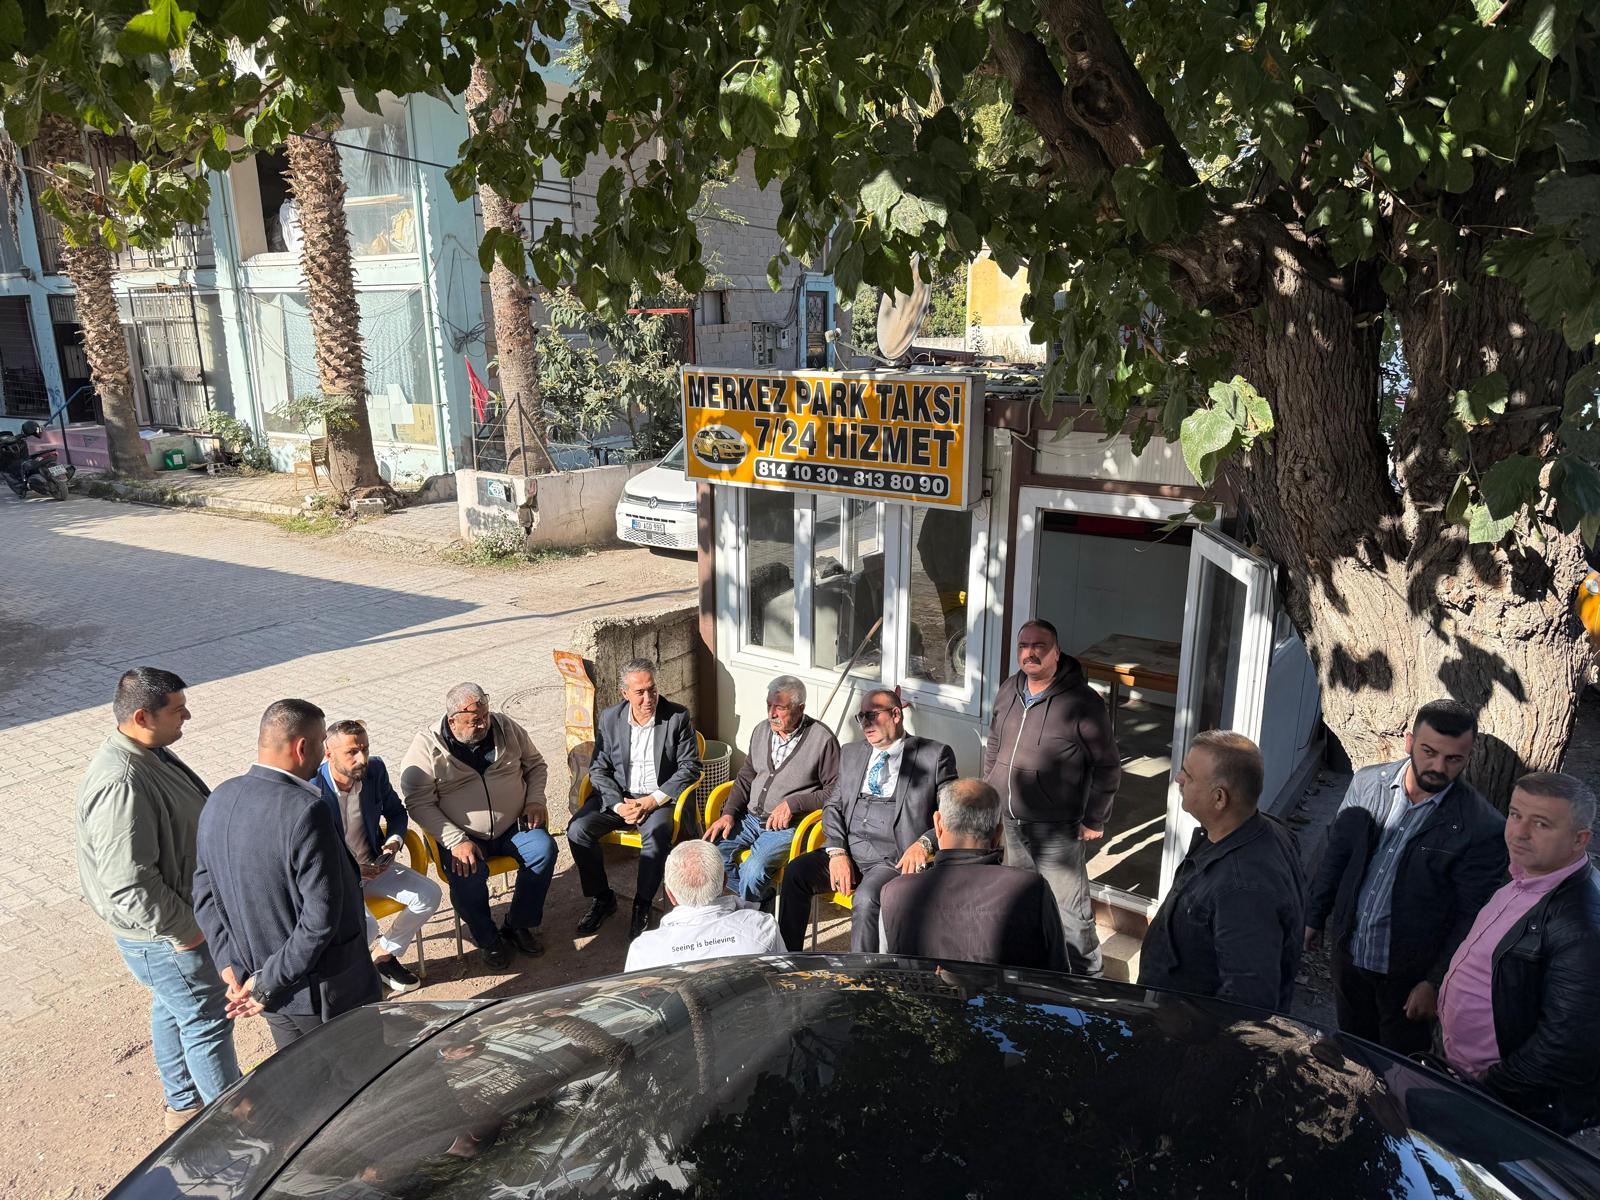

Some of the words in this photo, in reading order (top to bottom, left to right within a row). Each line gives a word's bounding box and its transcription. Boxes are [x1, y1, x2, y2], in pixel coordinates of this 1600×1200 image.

[687, 375, 788, 413] MERKEZ
[796, 380, 868, 419] PARK
[754, 417, 817, 456] 7/24
[758, 463, 787, 478] 814
[793, 466, 812, 480] 10
[816, 467, 838, 483] 30
[853, 471, 885, 489] 813
[890, 474, 914, 492] 80
[920, 475, 945, 494] 90
[671, 943, 694, 952] Seeing
[704, 936, 735, 946] believing
